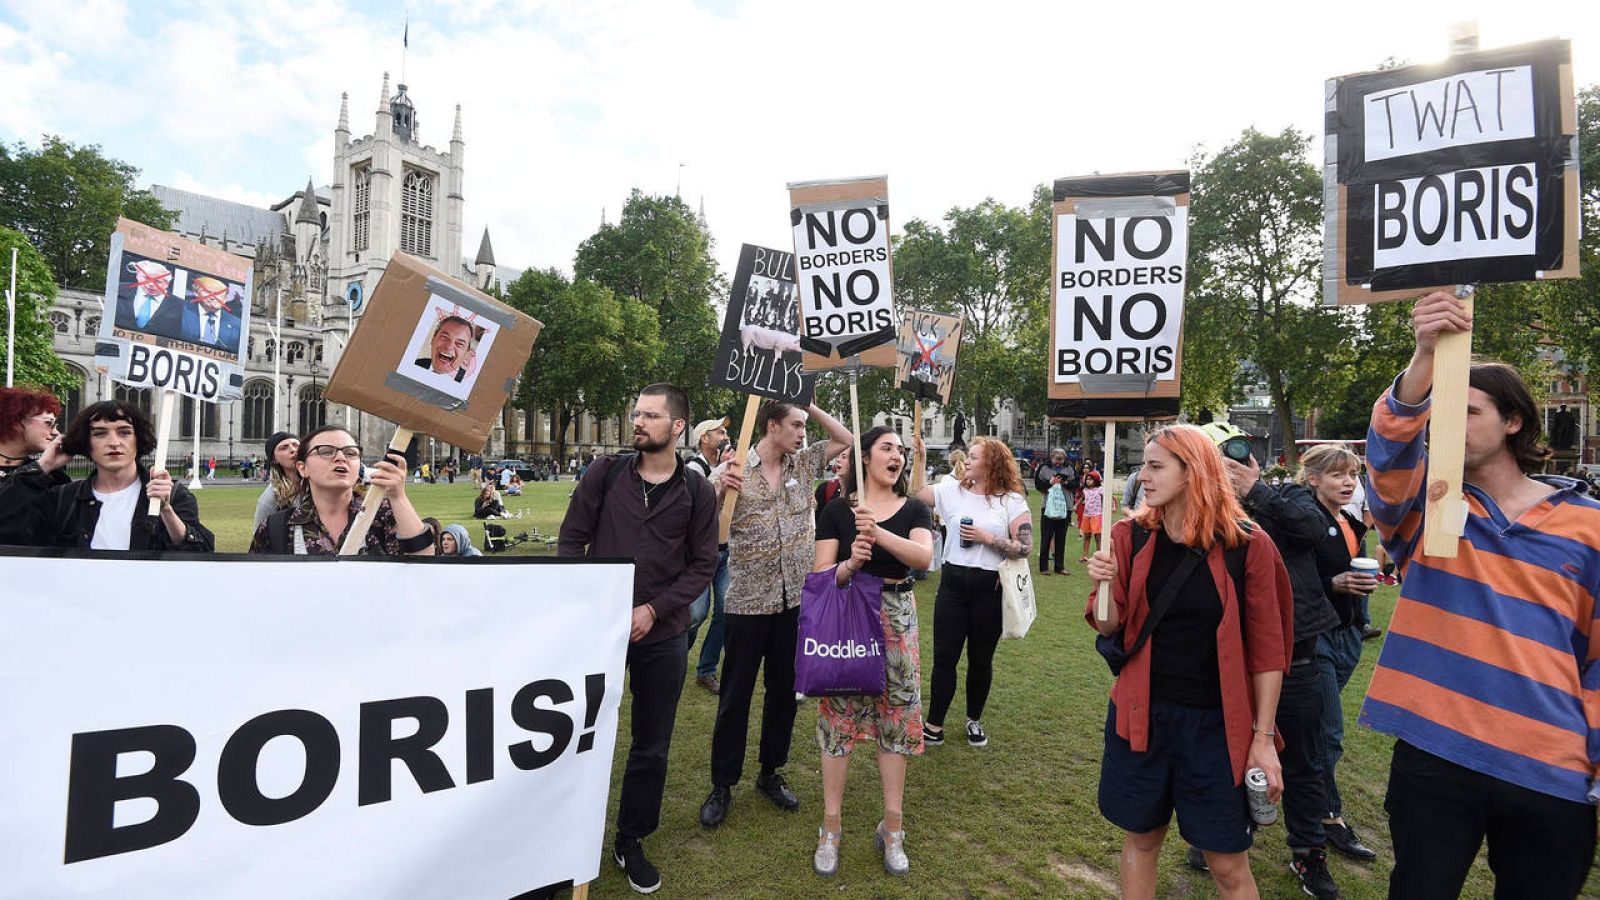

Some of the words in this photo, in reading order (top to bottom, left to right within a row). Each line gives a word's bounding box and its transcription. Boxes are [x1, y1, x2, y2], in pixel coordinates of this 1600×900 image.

[1371, 69, 1516, 149] TWAT
[805, 207, 876, 250] NO
[1377, 165, 1533, 251] BORIS
[800, 247, 887, 271] BORDERS
[1075, 215, 1173, 264] NO
[812, 269, 880, 311] NO
[1060, 265, 1182, 289] BORDERS
[805, 308, 892, 337] BORIS
[903, 310, 940, 338] FUCK
[1073, 292, 1167, 342] NO
[127, 345, 220, 399] BORIS
[725, 348, 804, 398] BULLYS
[1057, 345, 1173, 376] BORIS
[804, 638, 881, 659] Doddle.it
[63, 673, 606, 865] BORIS!
